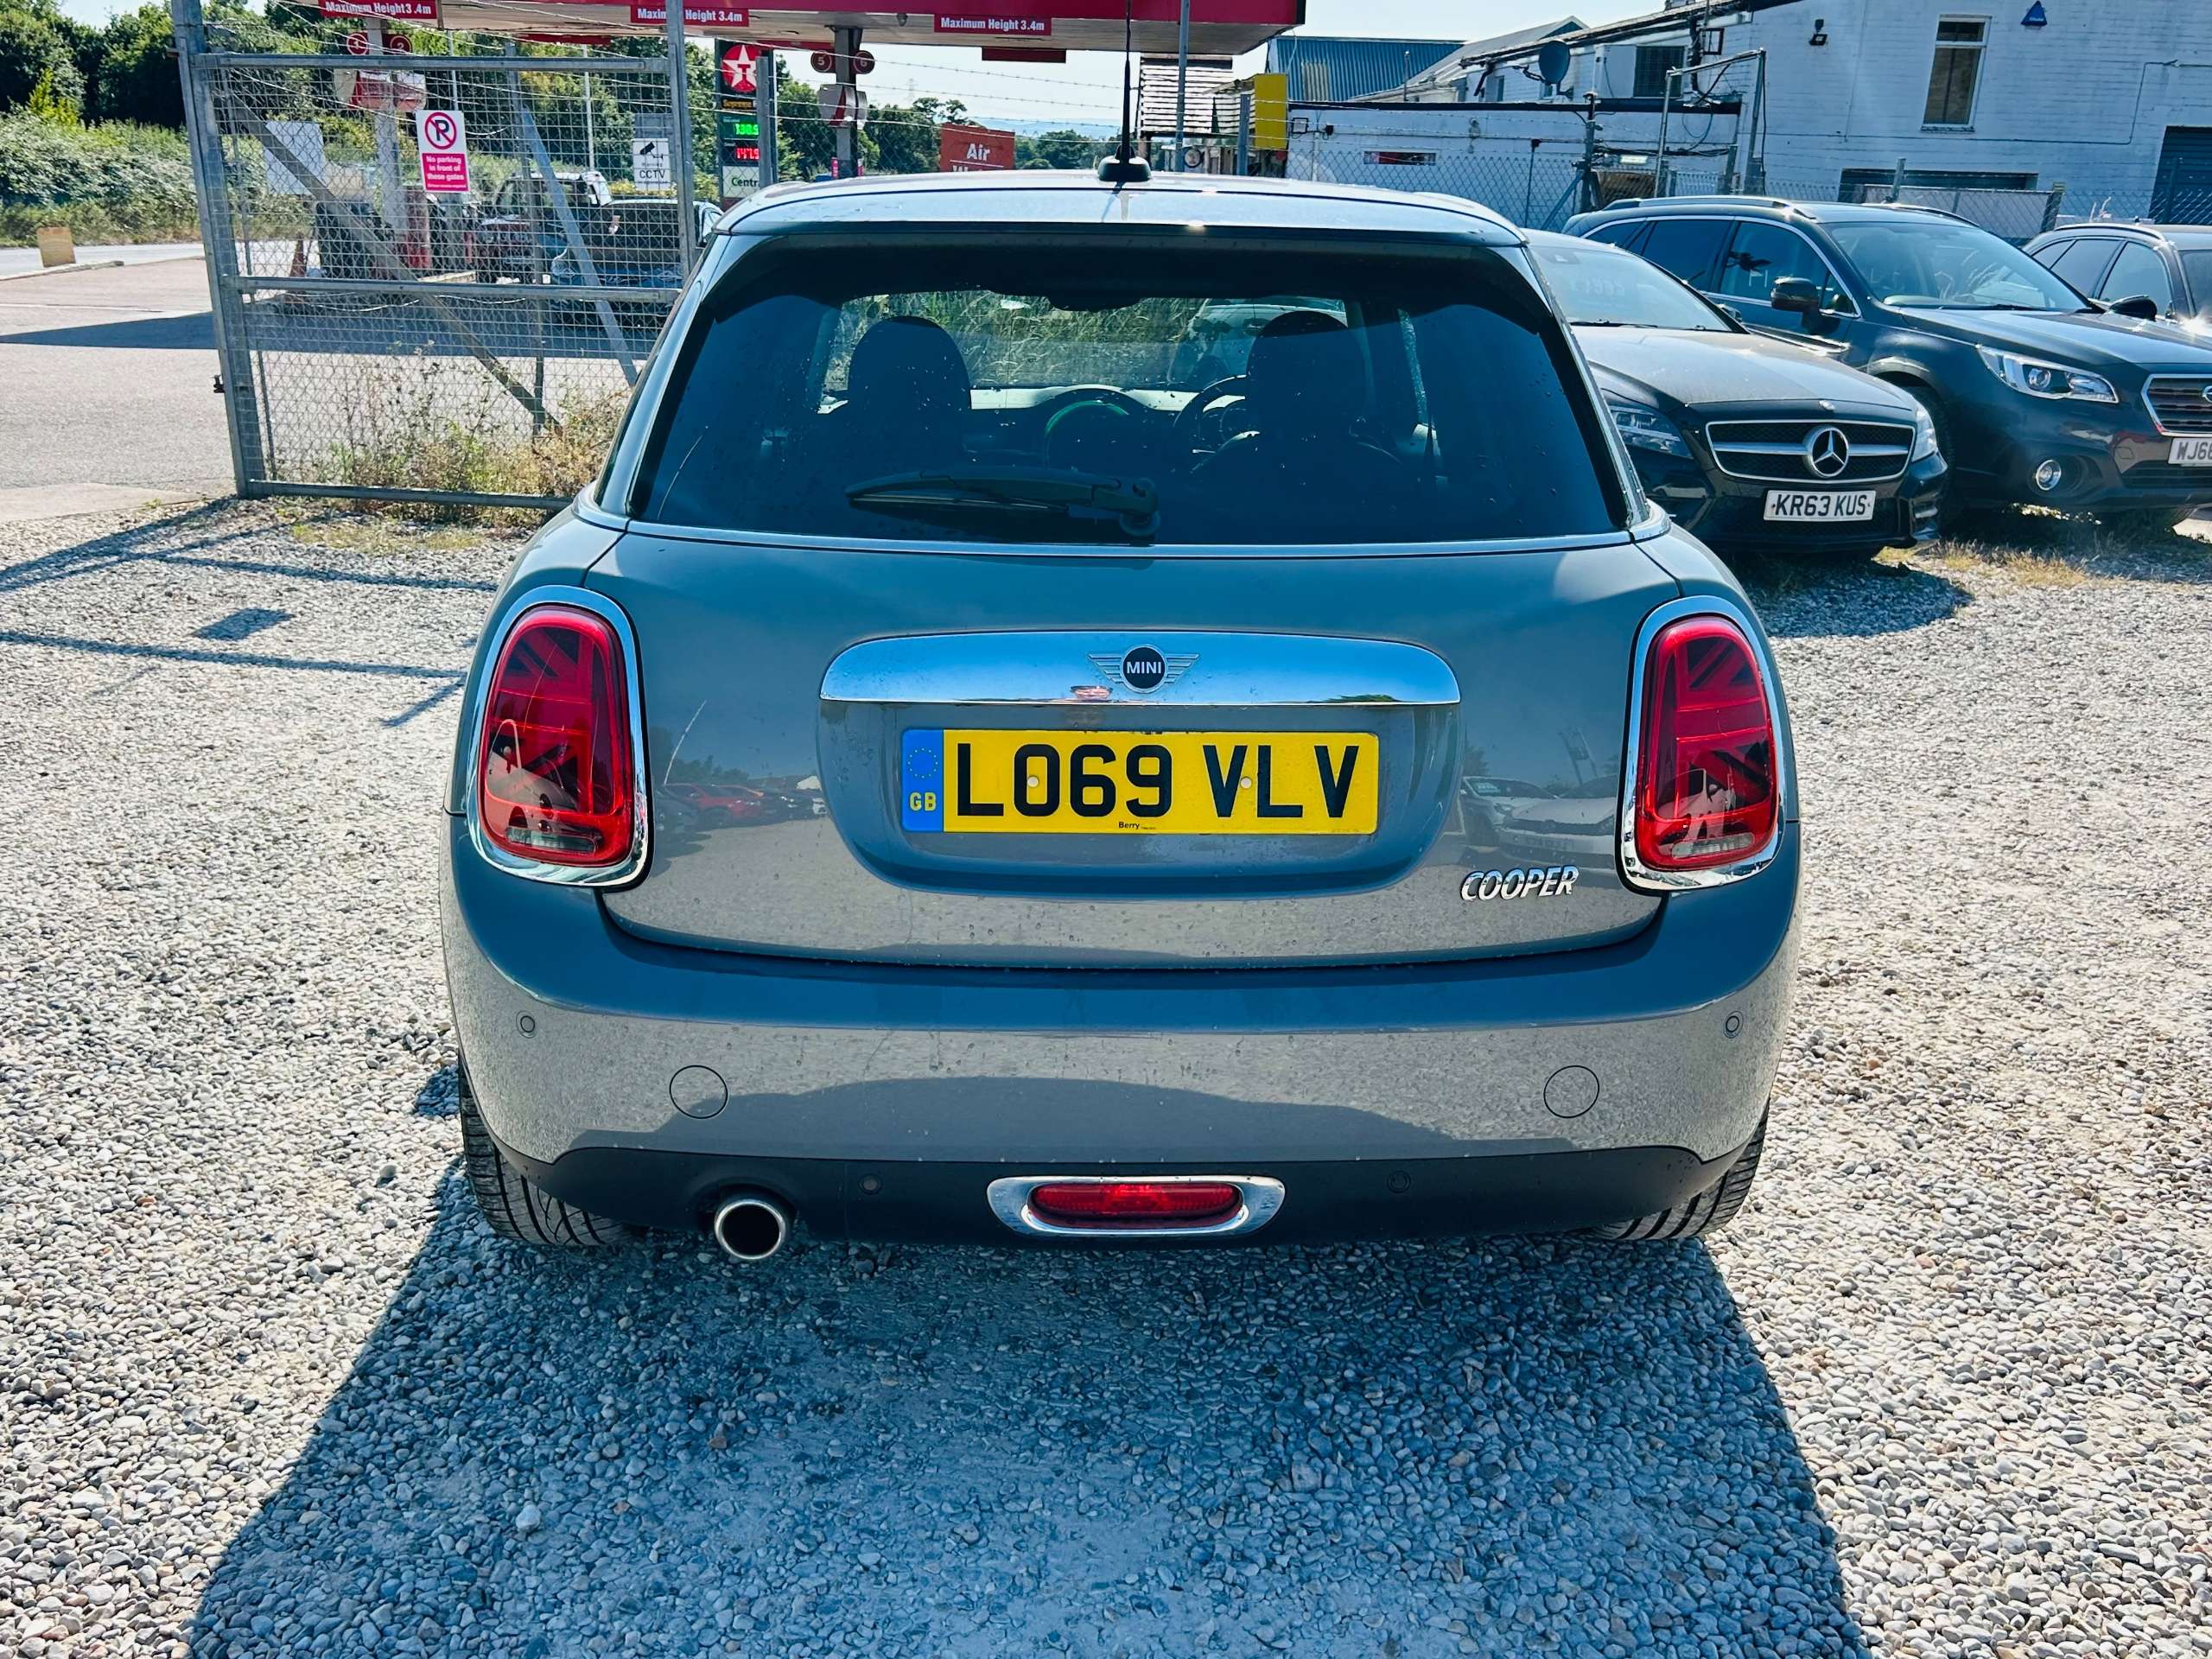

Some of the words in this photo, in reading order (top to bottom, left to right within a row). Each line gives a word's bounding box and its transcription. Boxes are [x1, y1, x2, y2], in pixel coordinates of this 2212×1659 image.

[325, 2, 372, 14] Maximum
[637, 9, 667, 19] Maxim
[685, 10, 716, 22] Height
[718, 11, 743, 22] 3.4m
[940, 17, 986, 29] Maximum
[988, 19, 1019, 31] Height
[1020, 20, 1045, 31] 3.4m
[817, 56, 825, 66] 5
[860, 57, 868, 67] 6
[967, 143, 990, 162] Air
[639, 169, 665, 179] CCTV
[731, 177, 760, 188] Centr
[1775, 493, 1831, 517] KR63
[1834, 494, 1867, 517] KUS
[1126, 661, 1162, 674] MINI
[957, 742, 1173, 818] LO69
[1203, 744, 1360, 818] VLV
[910, 791, 937, 811] GB
[1118, 821, 1141, 830] Berry
[1460, 865, 1580, 902] COOPER
